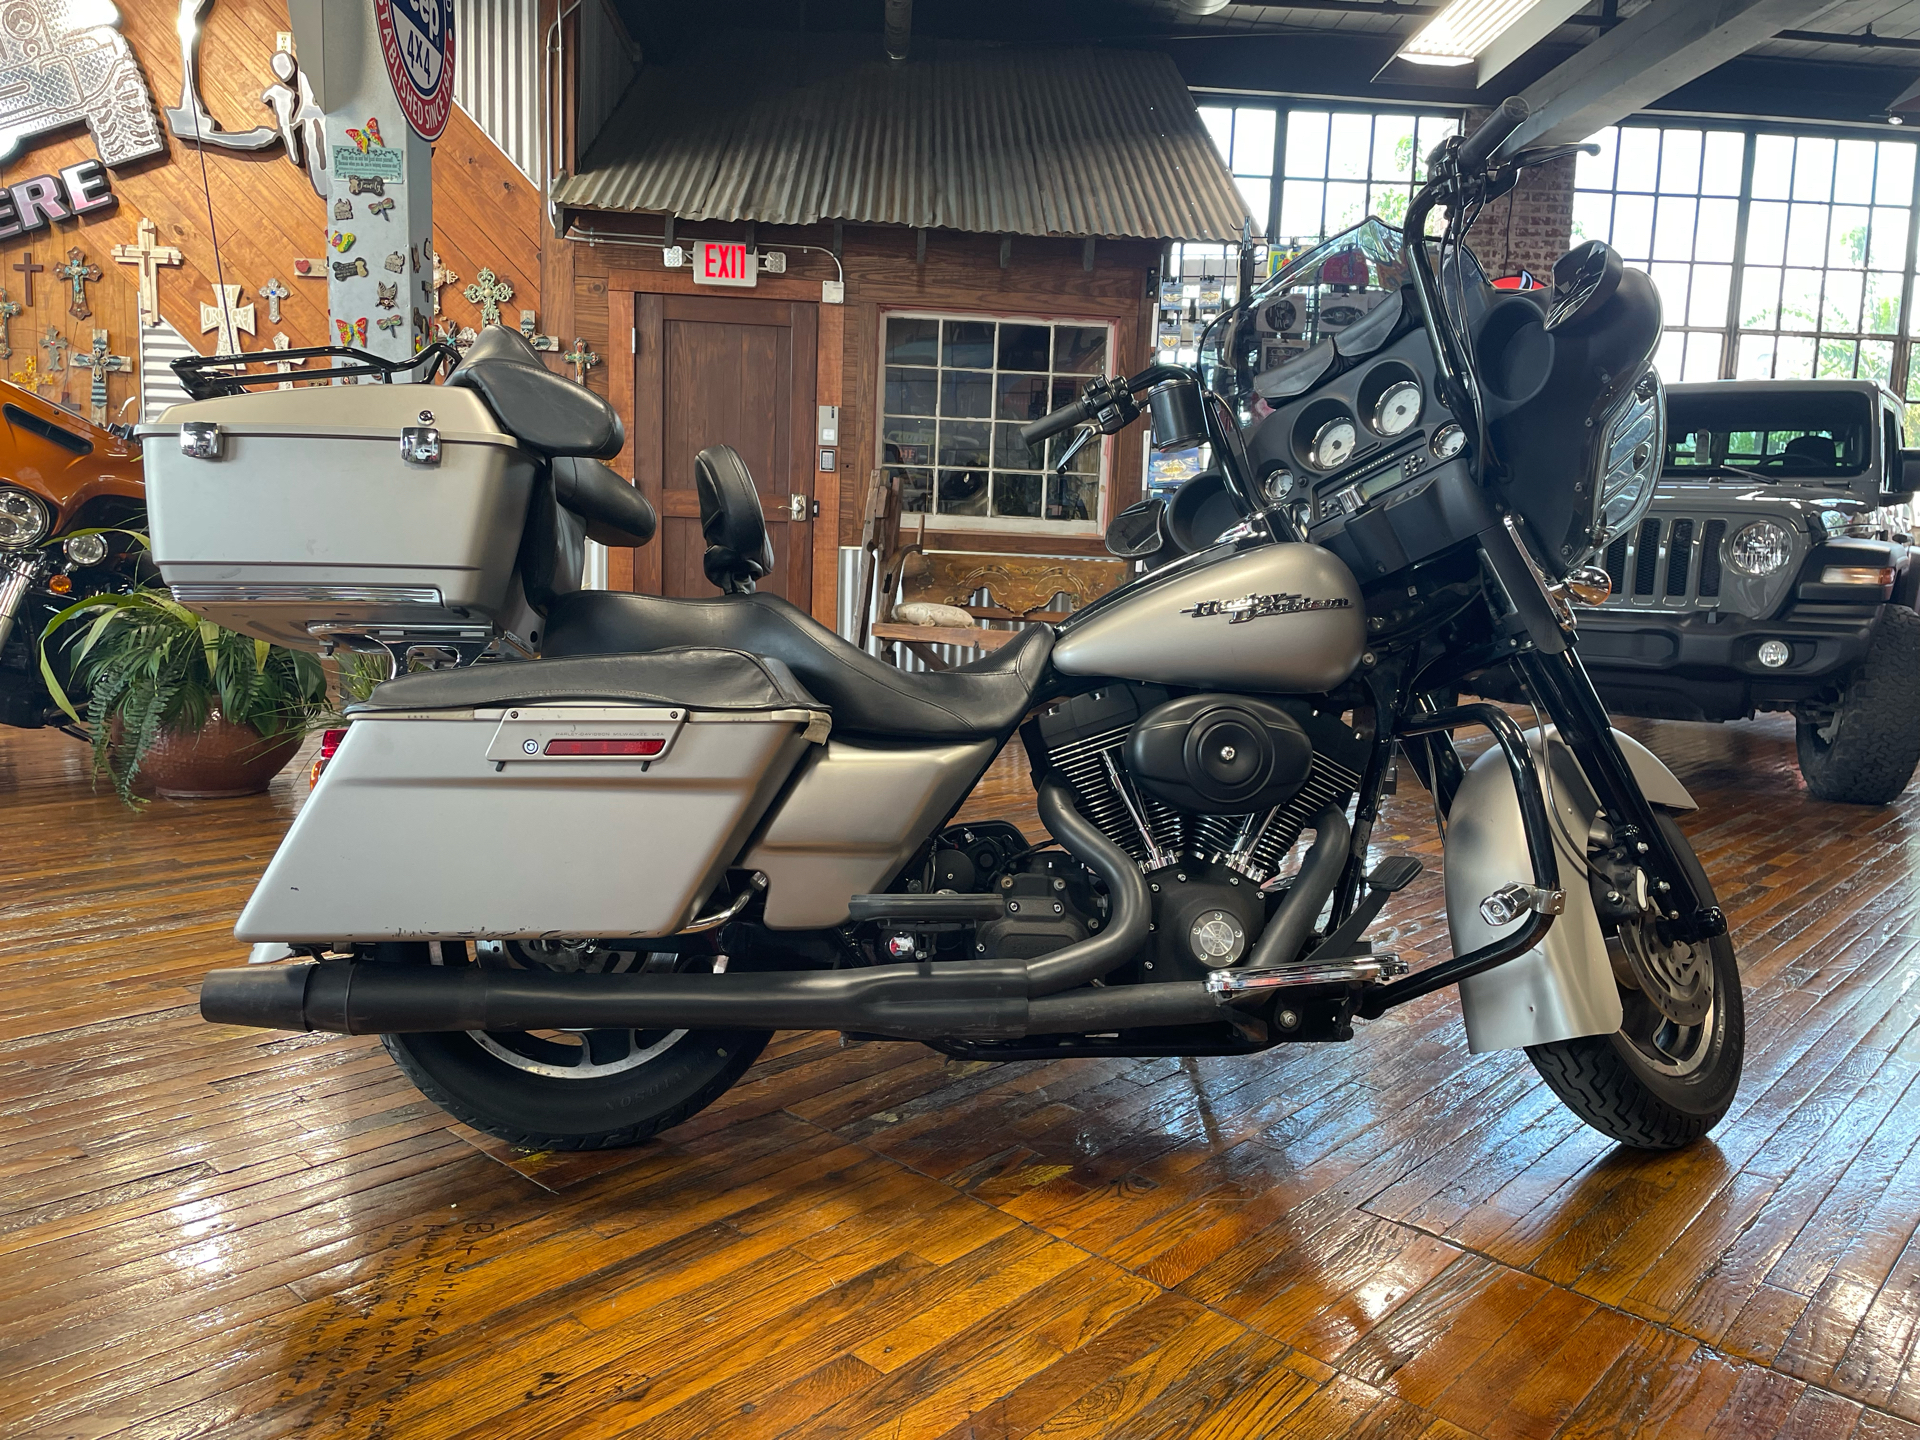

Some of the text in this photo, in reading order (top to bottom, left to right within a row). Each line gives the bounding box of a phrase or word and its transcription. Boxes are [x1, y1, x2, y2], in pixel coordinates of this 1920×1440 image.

[425, 93, 446, 129] SINCE
[705, 243, 746, 279] EXIT
[455, 1222, 496, 1256] But
